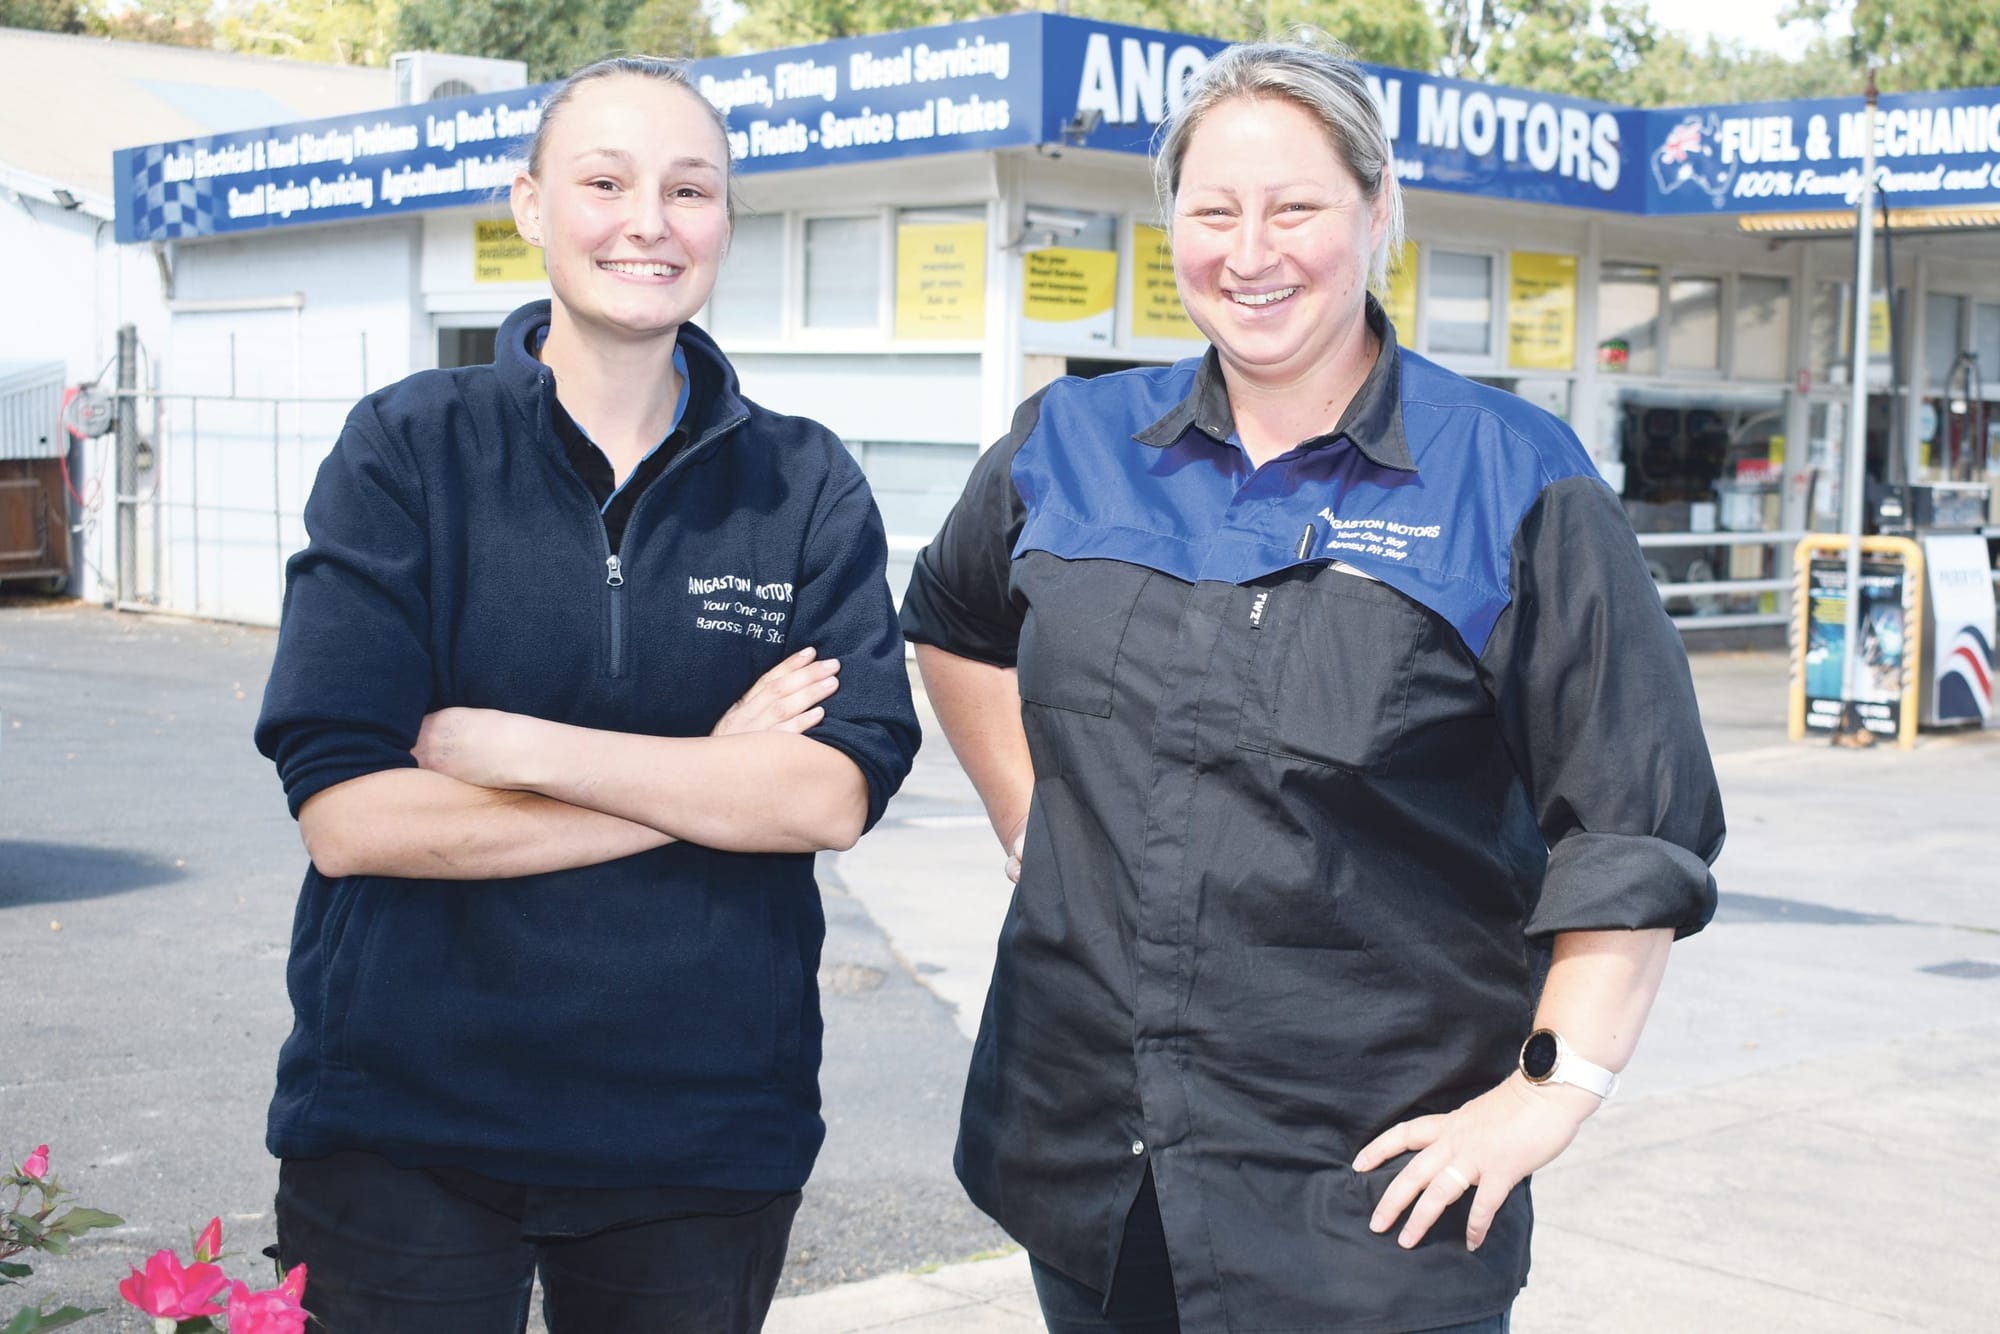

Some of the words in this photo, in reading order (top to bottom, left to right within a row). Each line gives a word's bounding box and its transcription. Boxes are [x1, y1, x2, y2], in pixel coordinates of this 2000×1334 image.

[163, 153, 193, 182] Auto
[195, 143, 253, 178] Electrical
[254, 141, 266, 171] &
[267, 136, 298, 169] Hard
[300, 129, 353, 165] Starting
[354, 121, 418, 158] Problems
[426, 115, 455, 151] Log
[456, 107, 496, 143] Book
[700, 68, 773, 115] Repairs,
[775, 59, 837, 101] Fitting
[850, 46, 912, 91] Diesel
[914, 35, 1010, 83] Servicing
[1417, 84, 1620, 191] MOTORS
[1721, 116, 1800, 164] FUEL
[1805, 115, 1832, 160] &
[228, 184, 264, 218] Small
[265, 180, 310, 218] Engine
[310, 172, 373, 209] Servicing
[381, 159, 464, 205] Agricultural
[750, 118, 808, 157] Floats
[820, 106, 894, 149] Service
[896, 100, 935, 141] and
[936, 94, 1010, 136] Brakes
[1733, 171, 1793, 198] 100%
[1793, 167, 1865, 205] Family
[1873, 163, 1946, 193] Owned
[1943, 162, 1992, 190] and
[1317, 507, 1384, 529] ANGASTON
[1386, 521, 1441, 538] MOTORS
[1336, 531, 1361, 539] Your
[1360, 531, 1384, 542] One
[1326, 540, 1365, 552] Barossa
[1365, 544, 1382, 555] Pit
[1382, 548, 1408, 560] Stop
[688, 576, 750, 595] ANGASTON
[703, 600, 732, 611] Your
[734, 602, 758, 617] One
[745, 623, 764, 639] Pit
